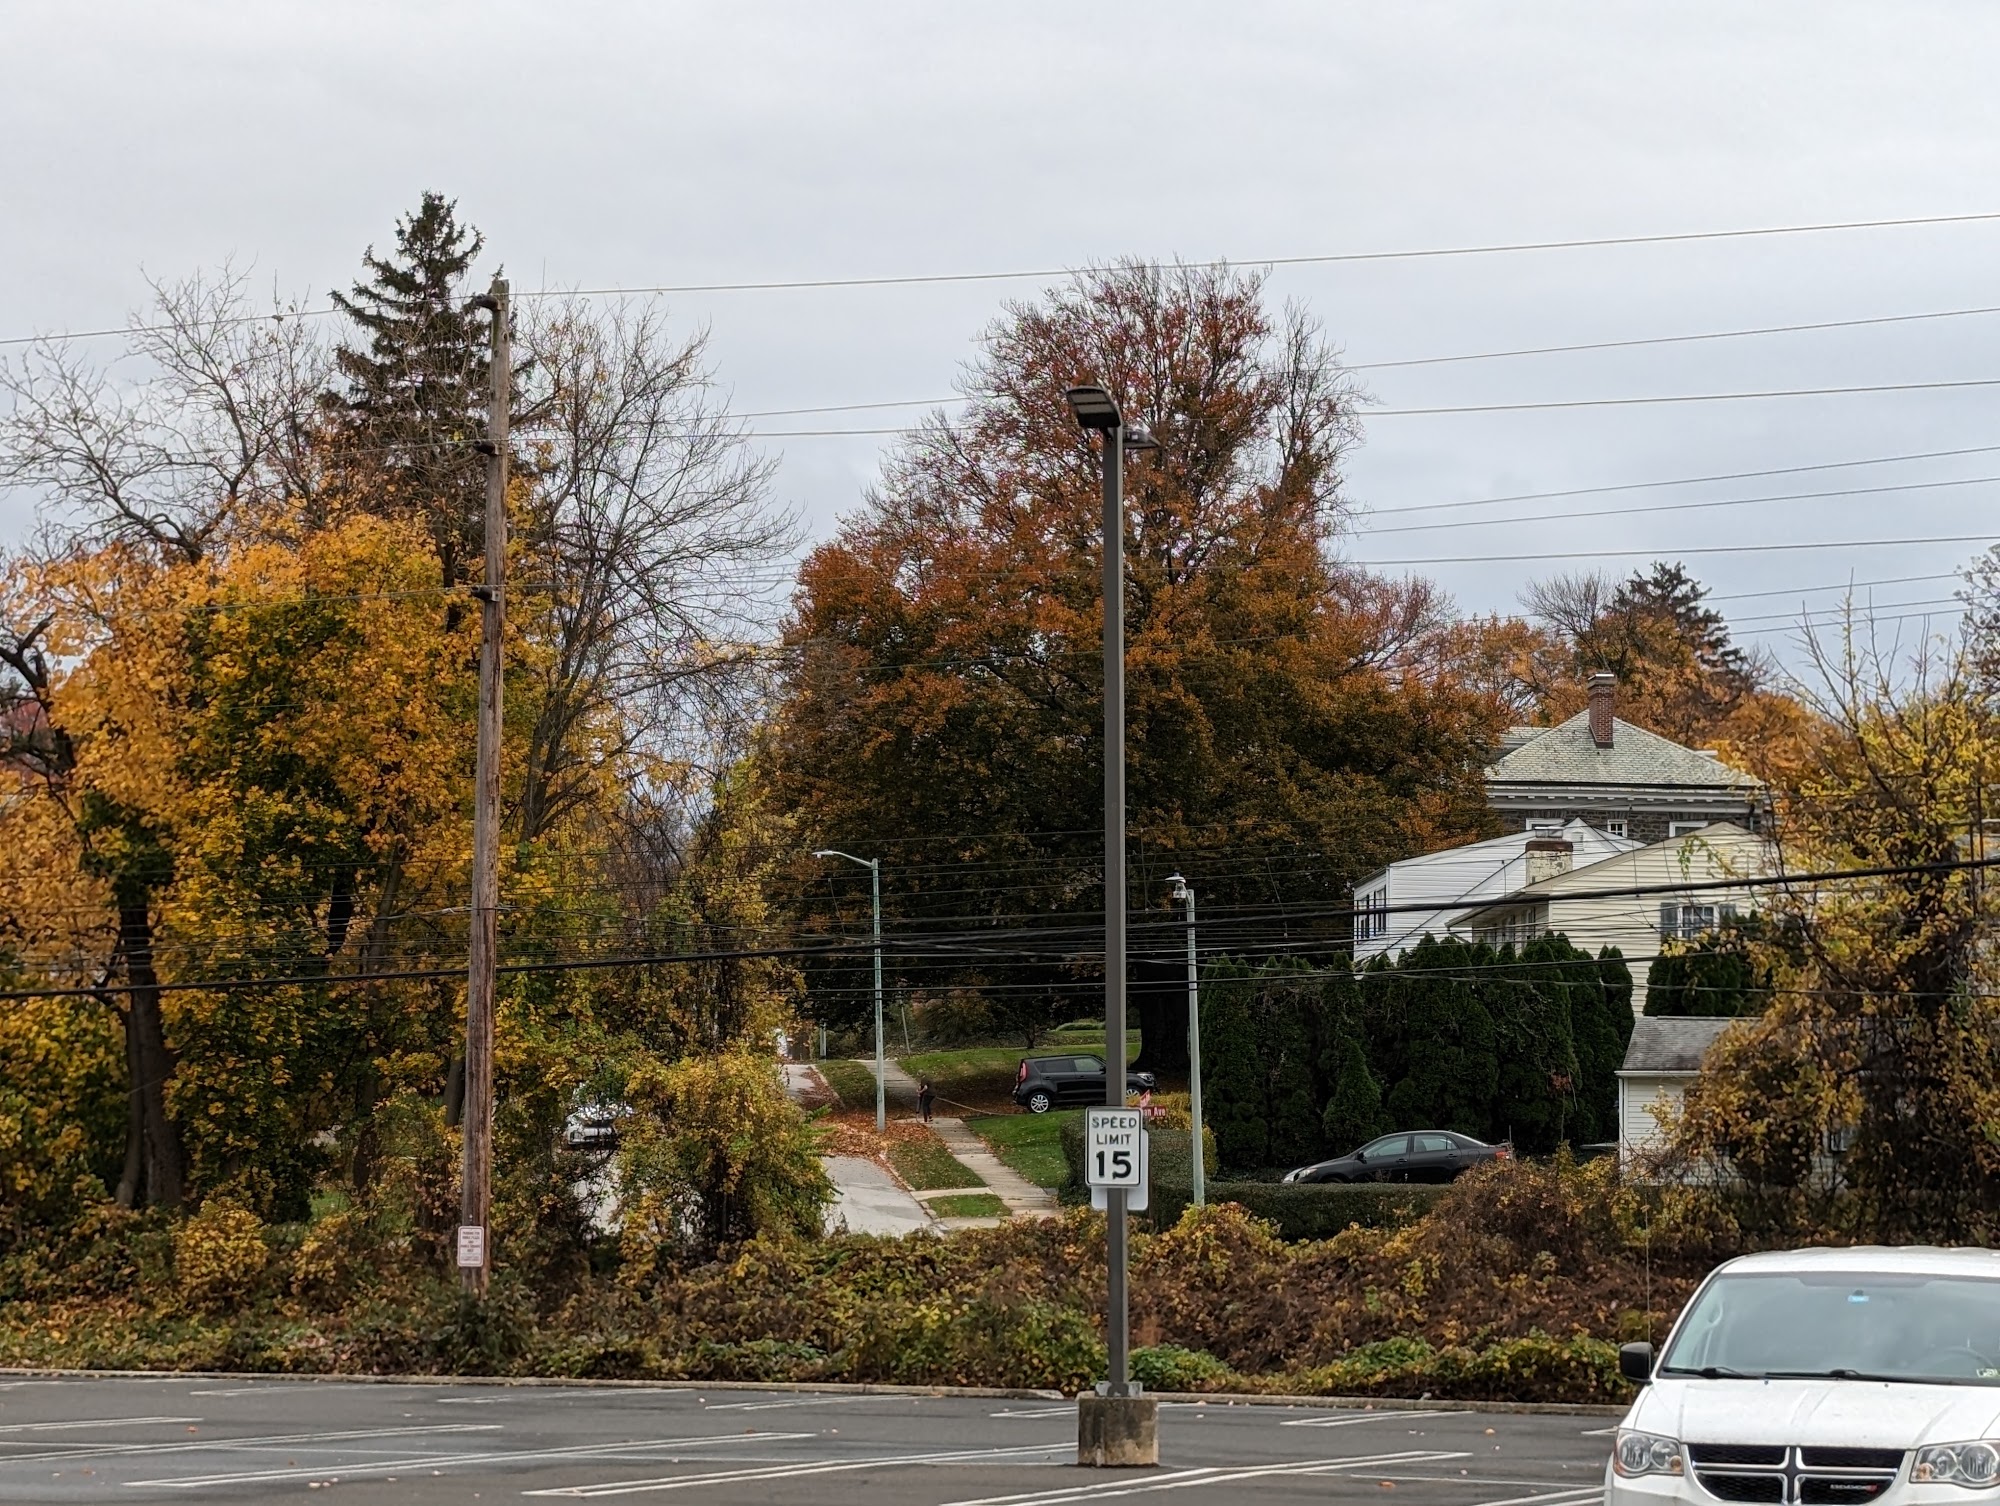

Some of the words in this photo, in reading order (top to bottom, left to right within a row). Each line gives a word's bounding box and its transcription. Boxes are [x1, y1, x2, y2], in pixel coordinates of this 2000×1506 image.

[1153, 1107, 1166, 1117] Ave
[1092, 1117, 1137, 1128] SPEED
[1096, 1133, 1132, 1145] LIMIT
[1096, 1151, 1132, 1180] 15
